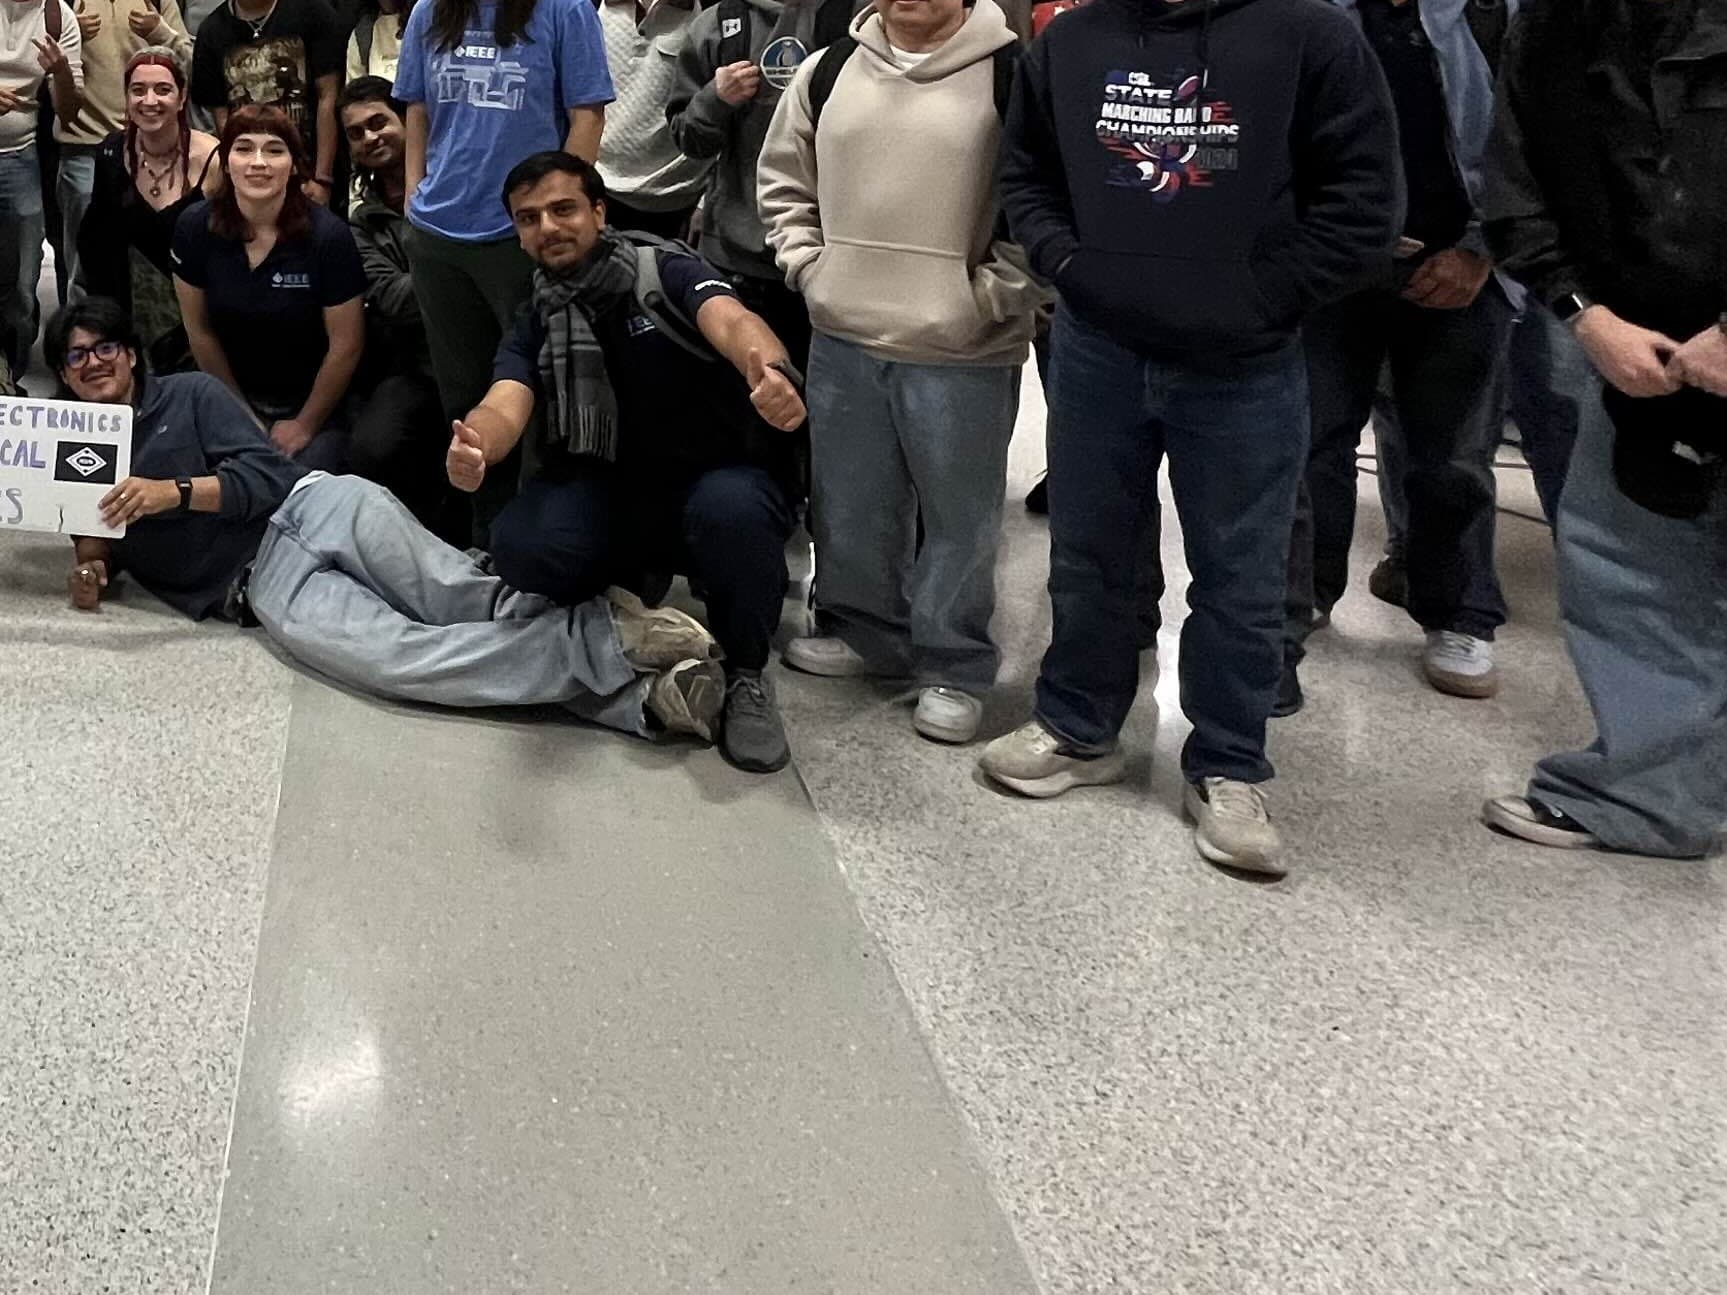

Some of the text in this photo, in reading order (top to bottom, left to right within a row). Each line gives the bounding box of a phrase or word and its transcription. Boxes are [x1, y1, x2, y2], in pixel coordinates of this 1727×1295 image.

[466, 45, 496, 58] IEEE
[1104, 84, 1173, 104] STATE
[1101, 102, 1171, 123] MARCHING
